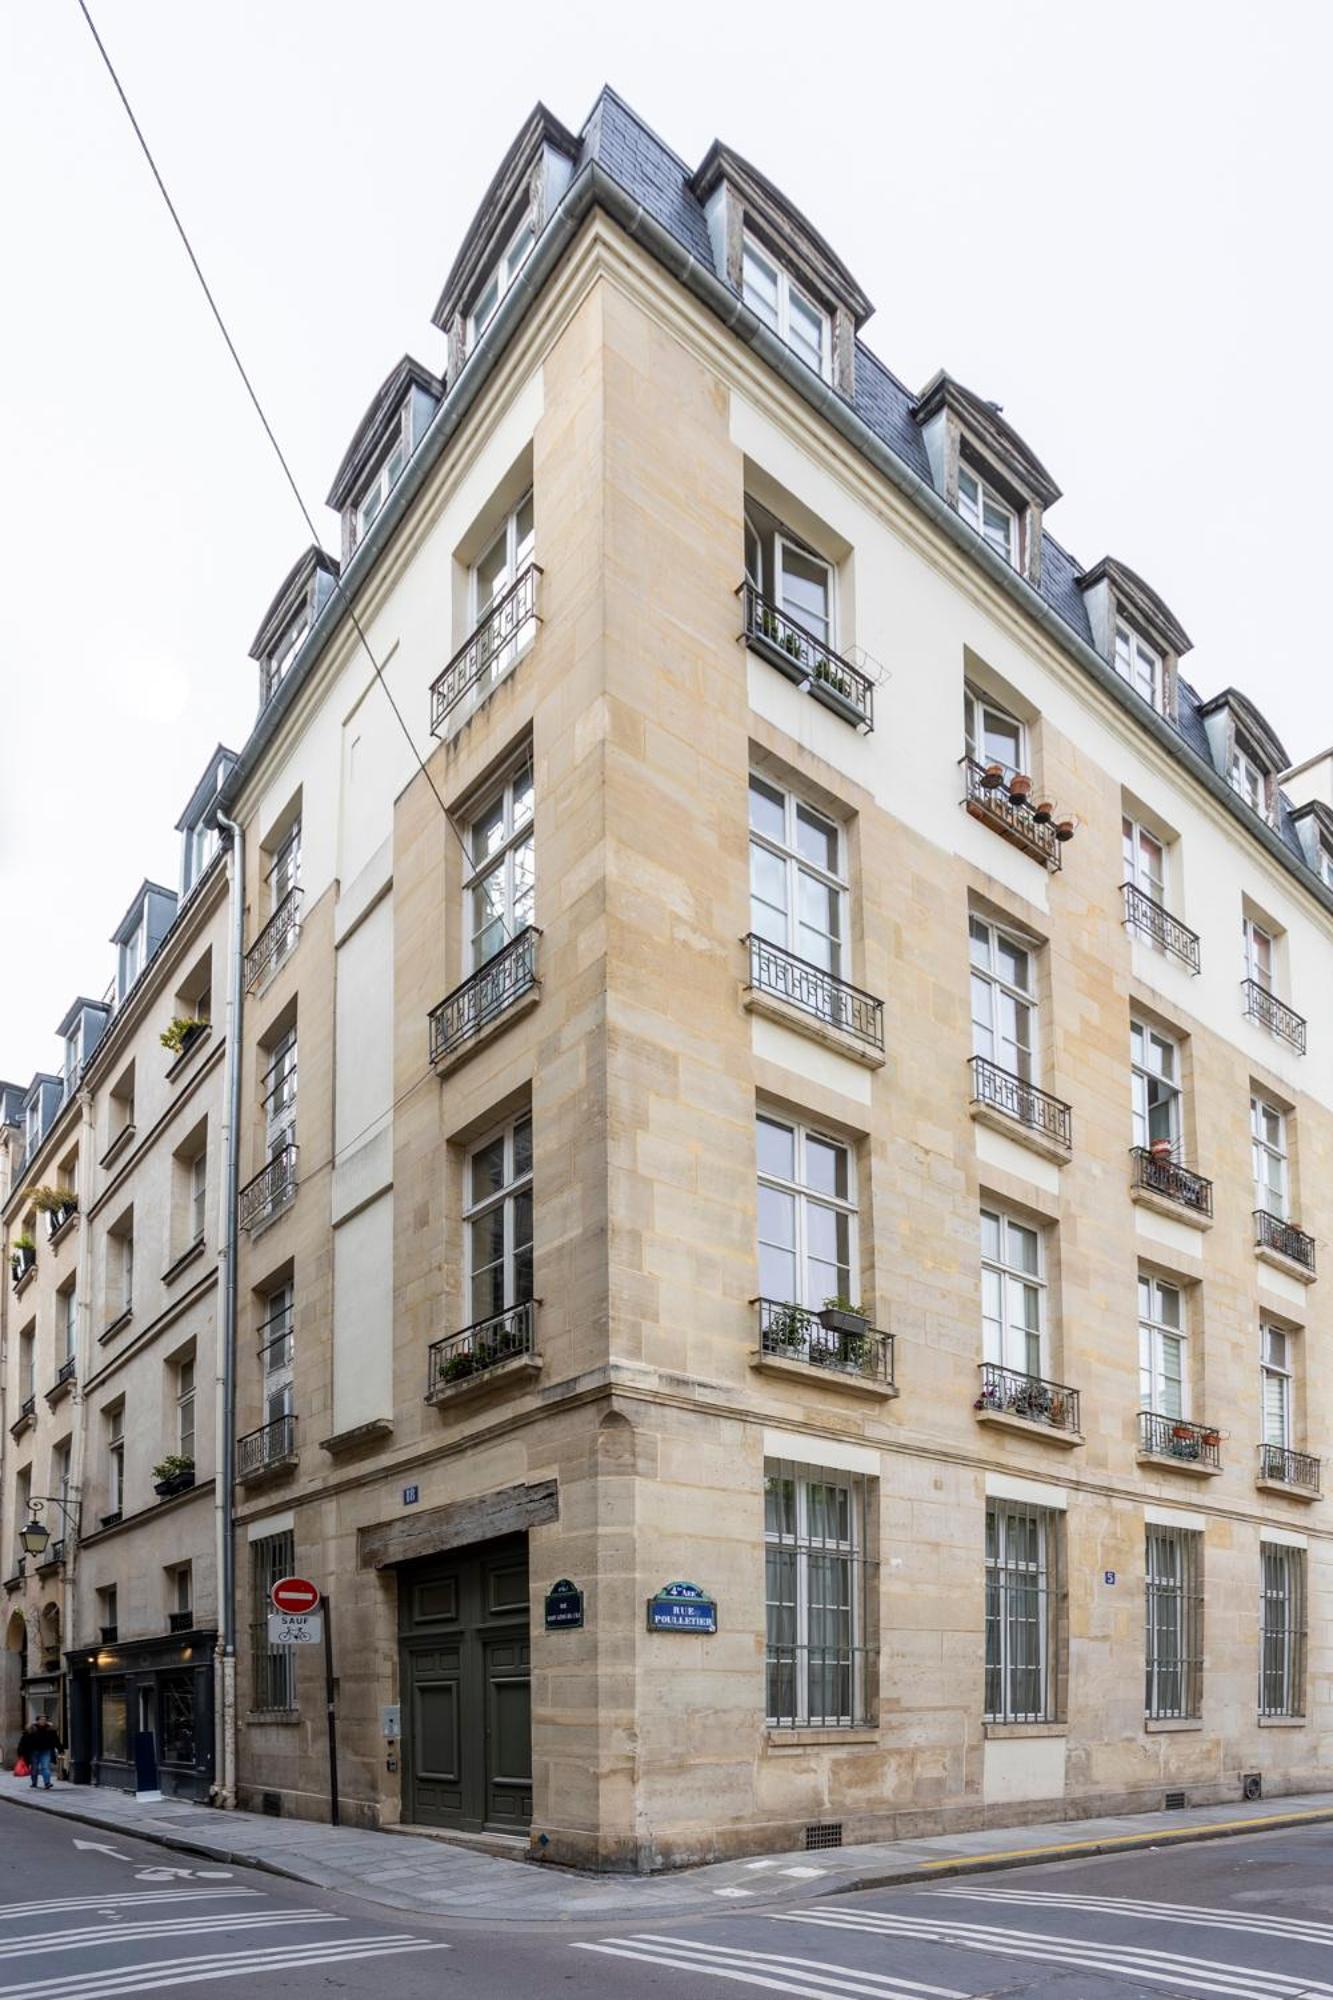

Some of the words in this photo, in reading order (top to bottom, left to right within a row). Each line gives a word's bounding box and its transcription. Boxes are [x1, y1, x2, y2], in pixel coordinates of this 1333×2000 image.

[1107, 1572, 1114, 1583] 5
[672, 1605, 695, 1615] RUE
[281, 1616, 308, 1625] SAUF
[654, 1615, 712, 1626] POULLETIER
